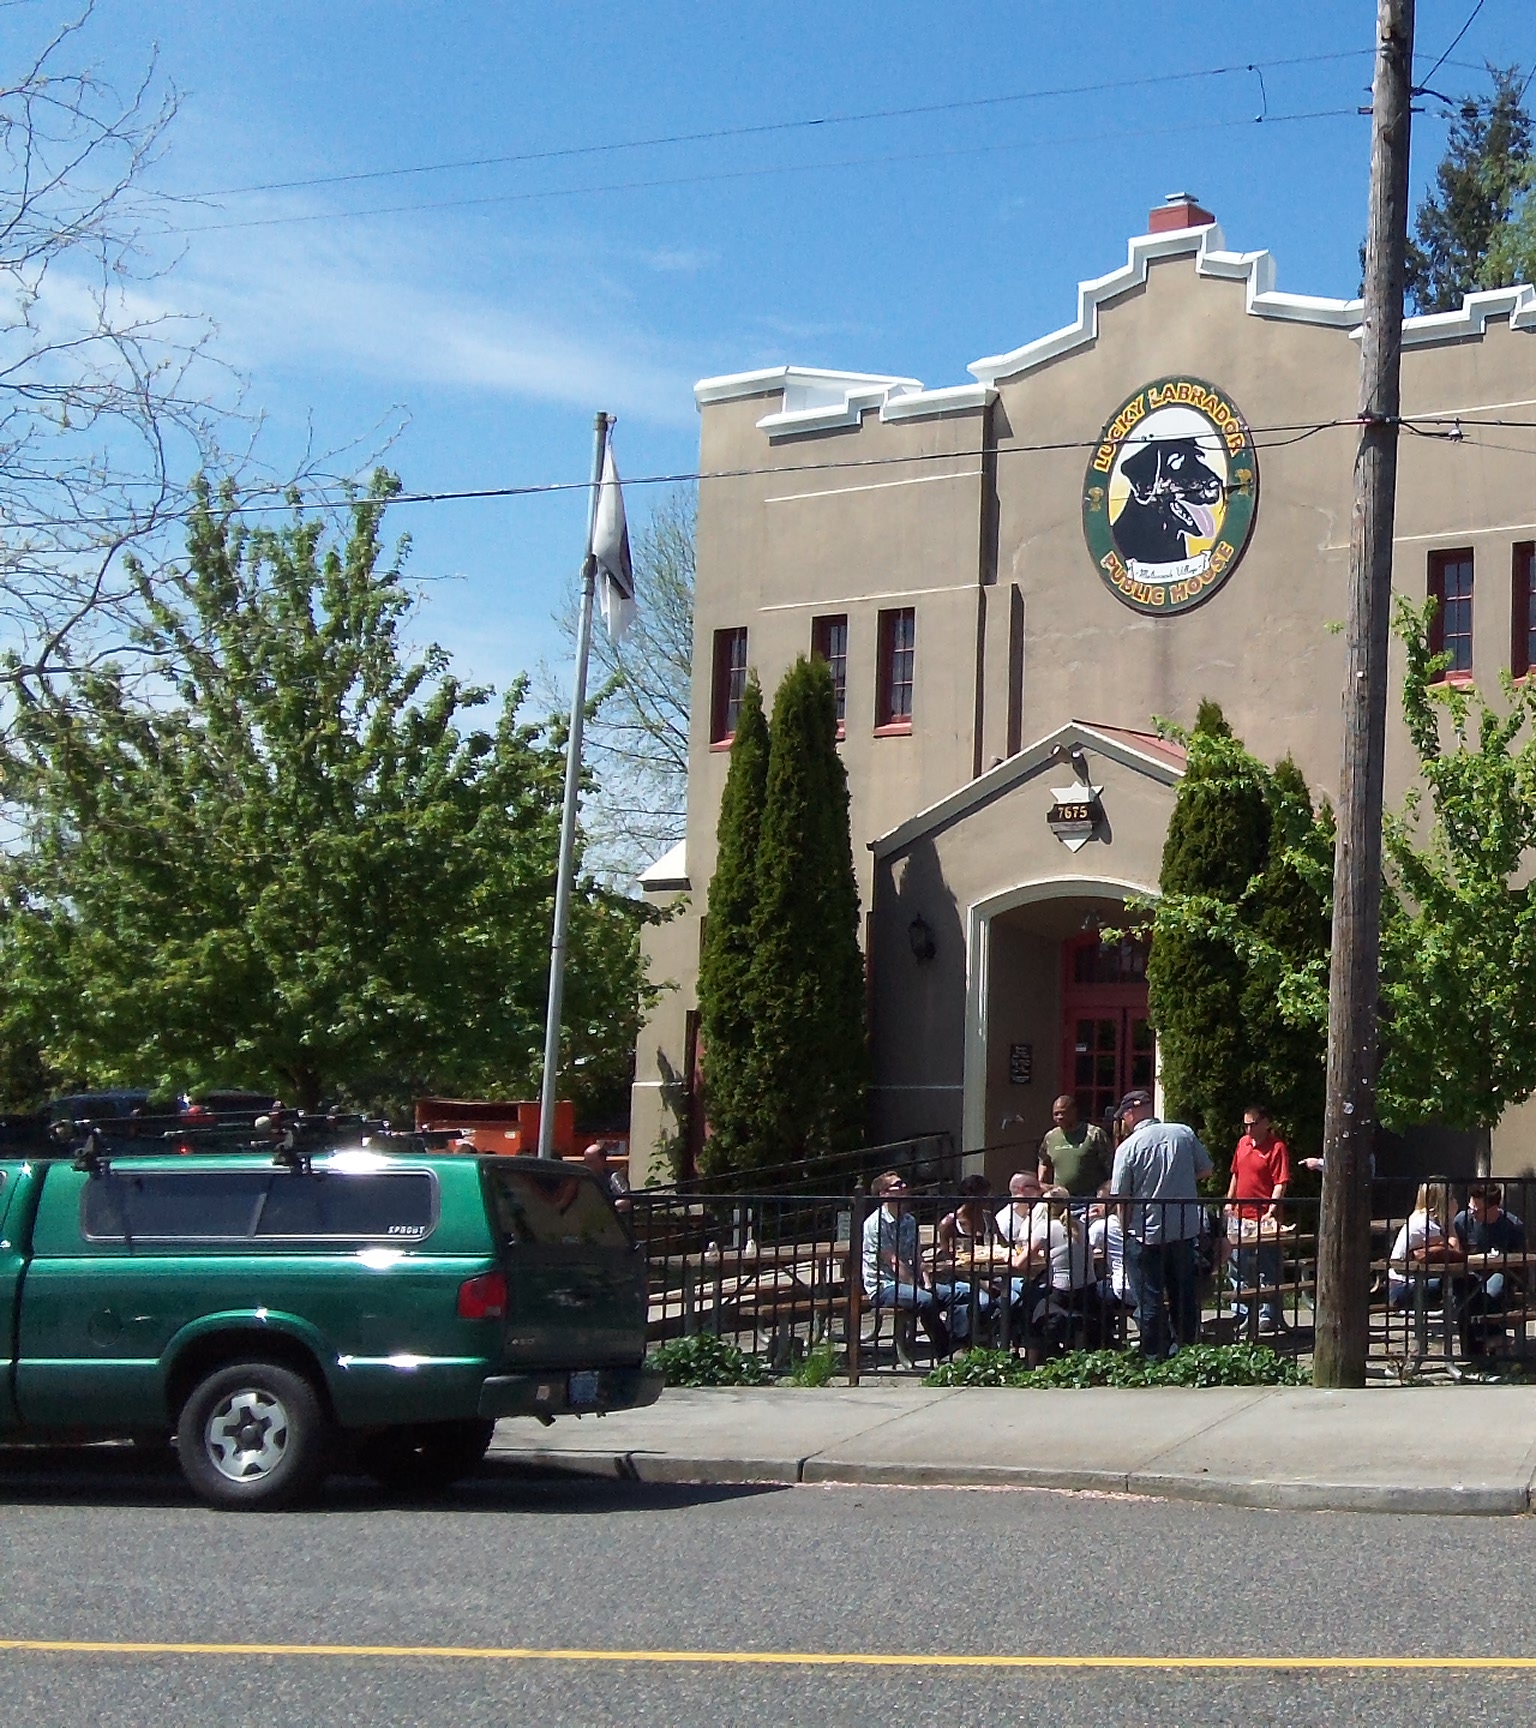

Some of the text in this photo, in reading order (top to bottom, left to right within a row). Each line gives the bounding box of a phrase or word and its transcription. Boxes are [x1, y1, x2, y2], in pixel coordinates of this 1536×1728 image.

[1093, 383, 1245, 473] LUCKY LABRADOR
[1100, 541, 1234, 605] PUBLIC HOUSE
[1058, 806, 1087, 819] 7675
